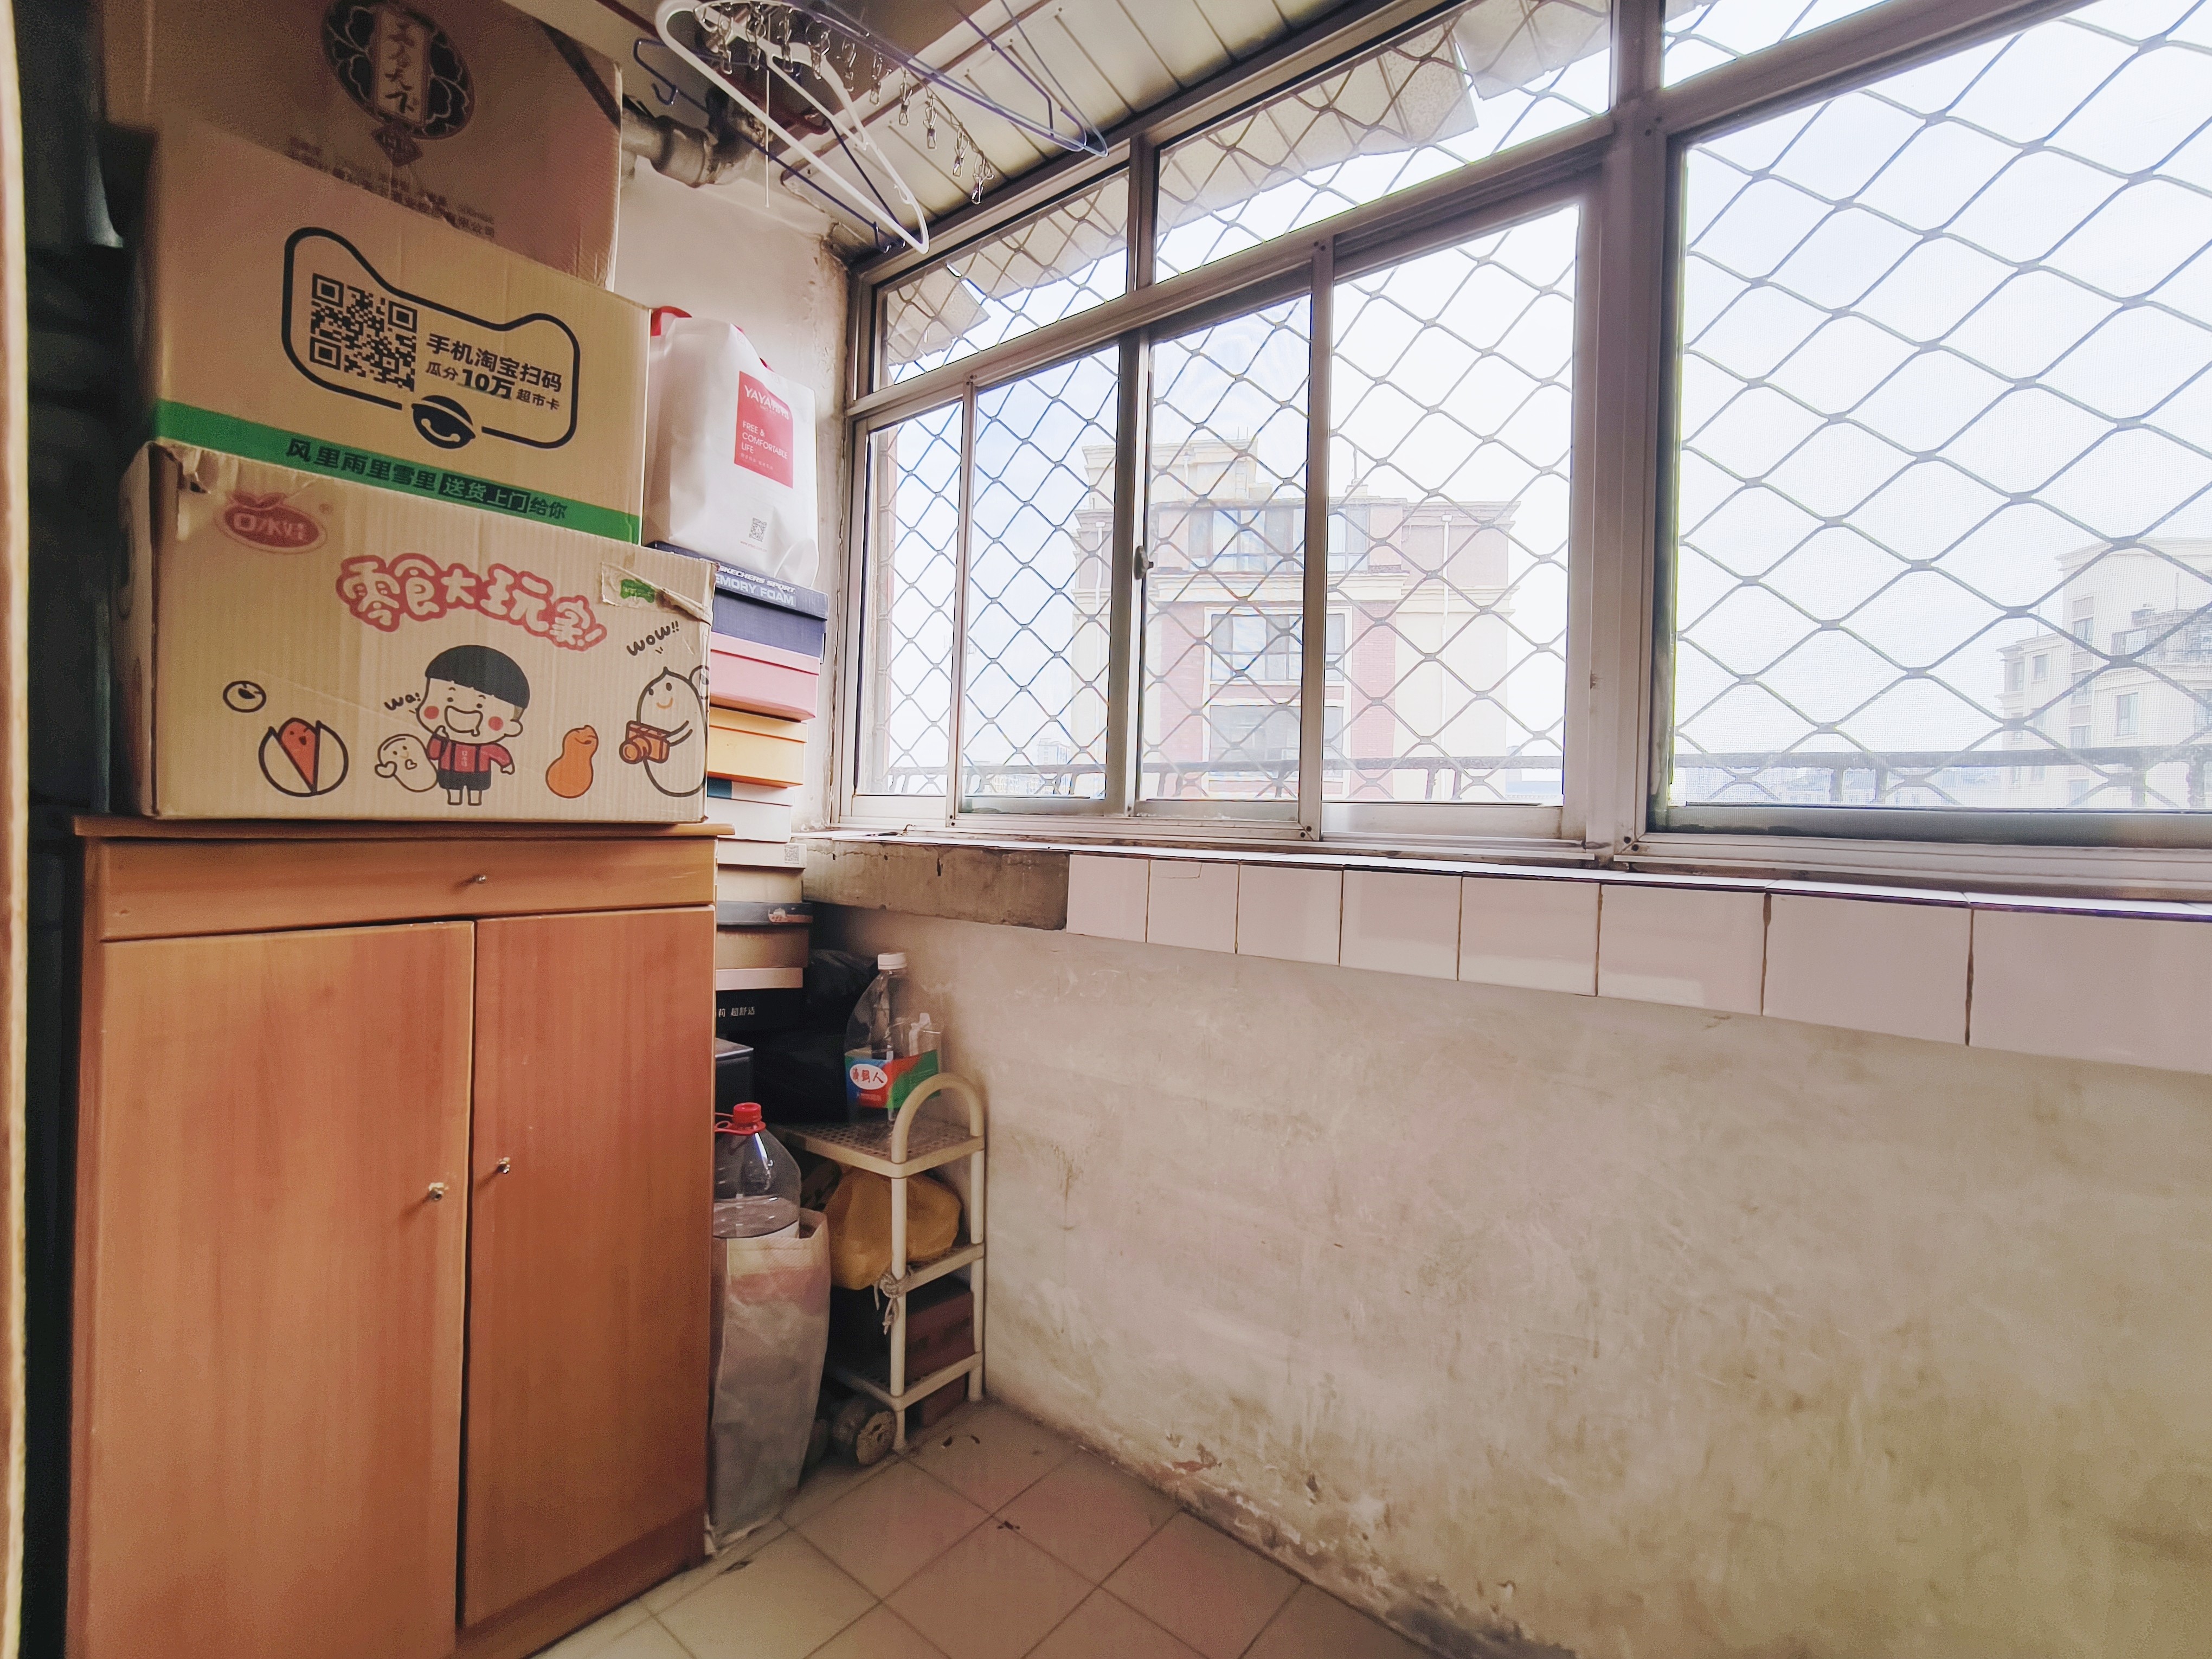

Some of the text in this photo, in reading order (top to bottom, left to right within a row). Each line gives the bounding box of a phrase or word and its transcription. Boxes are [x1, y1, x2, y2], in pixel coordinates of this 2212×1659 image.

[426, 333, 562, 393] 手机淘宝扫码
[743, 421, 765, 437] FREE &
[741, 442, 754, 454] LIFE
[742, 432, 788, 459] COMFORTABLE
[716, 574, 794, 606] EMORY FOAM
[719, 565, 795, 594] SKECHERS SPORT
